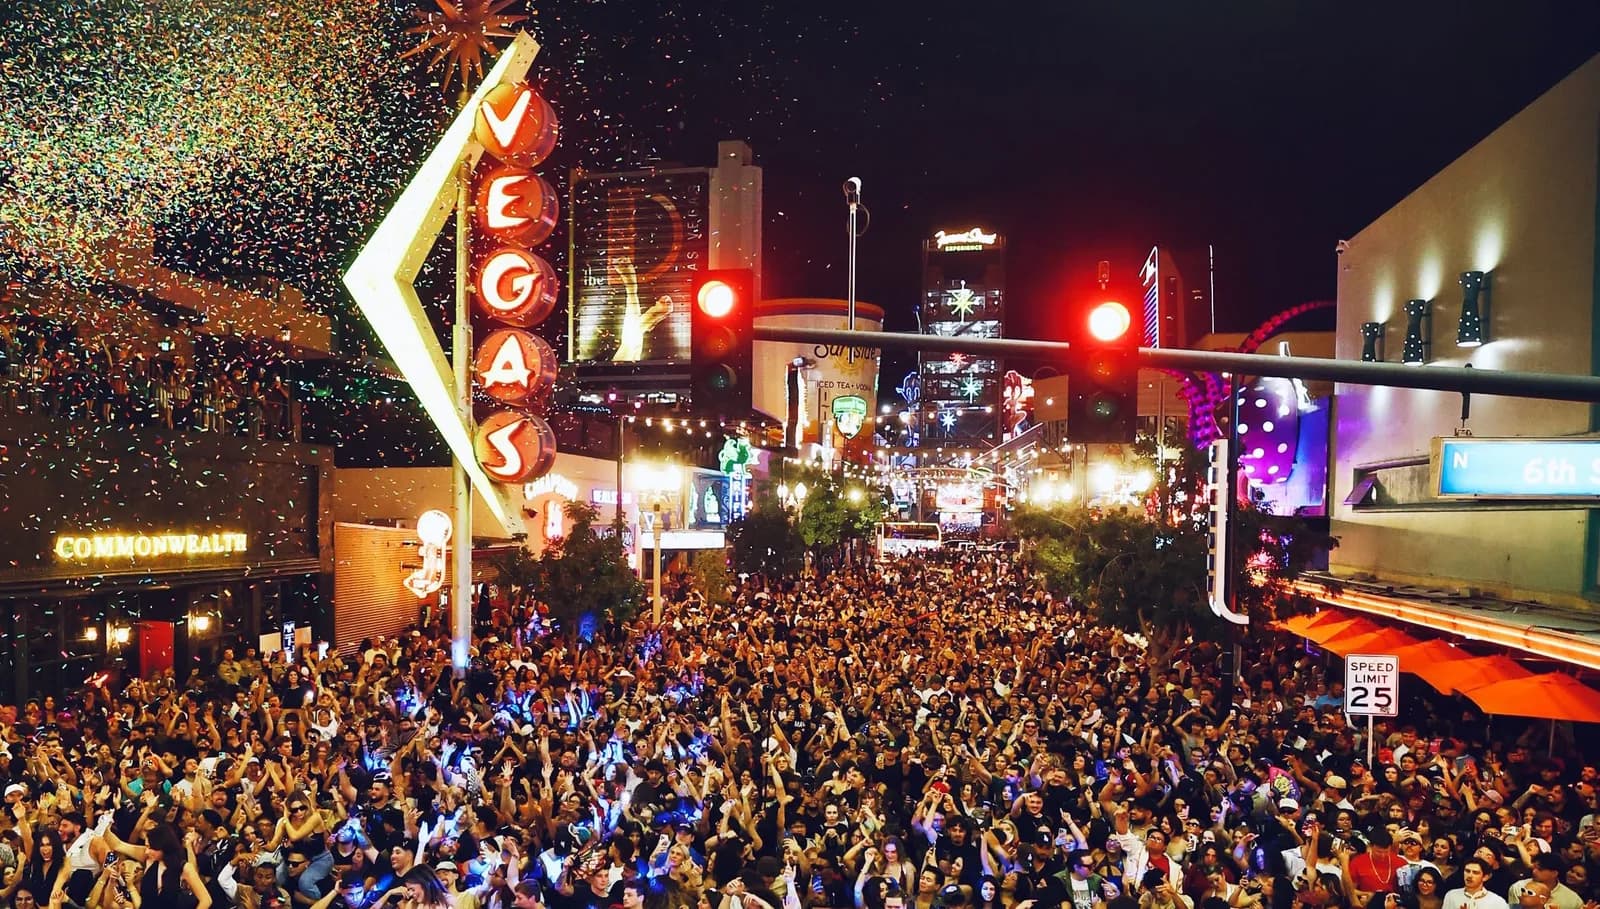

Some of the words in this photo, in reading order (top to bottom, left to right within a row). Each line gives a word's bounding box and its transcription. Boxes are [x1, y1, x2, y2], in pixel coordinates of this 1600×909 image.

[482, 89, 543, 476] VEGAS
[814, 344, 875, 359] Surside
[816, 380, 834, 388] ICED
[837, 381, 850, 389] TEA
[1453, 451, 1468, 469] N
[1523, 457, 1576, 484] 6th
[55, 534, 247, 558] COMMONWEALTH
[1351, 662, 1394, 672] SPEED
[1355, 674, 1388, 684] LIMIT
[1351, 687, 1392, 707] 25
